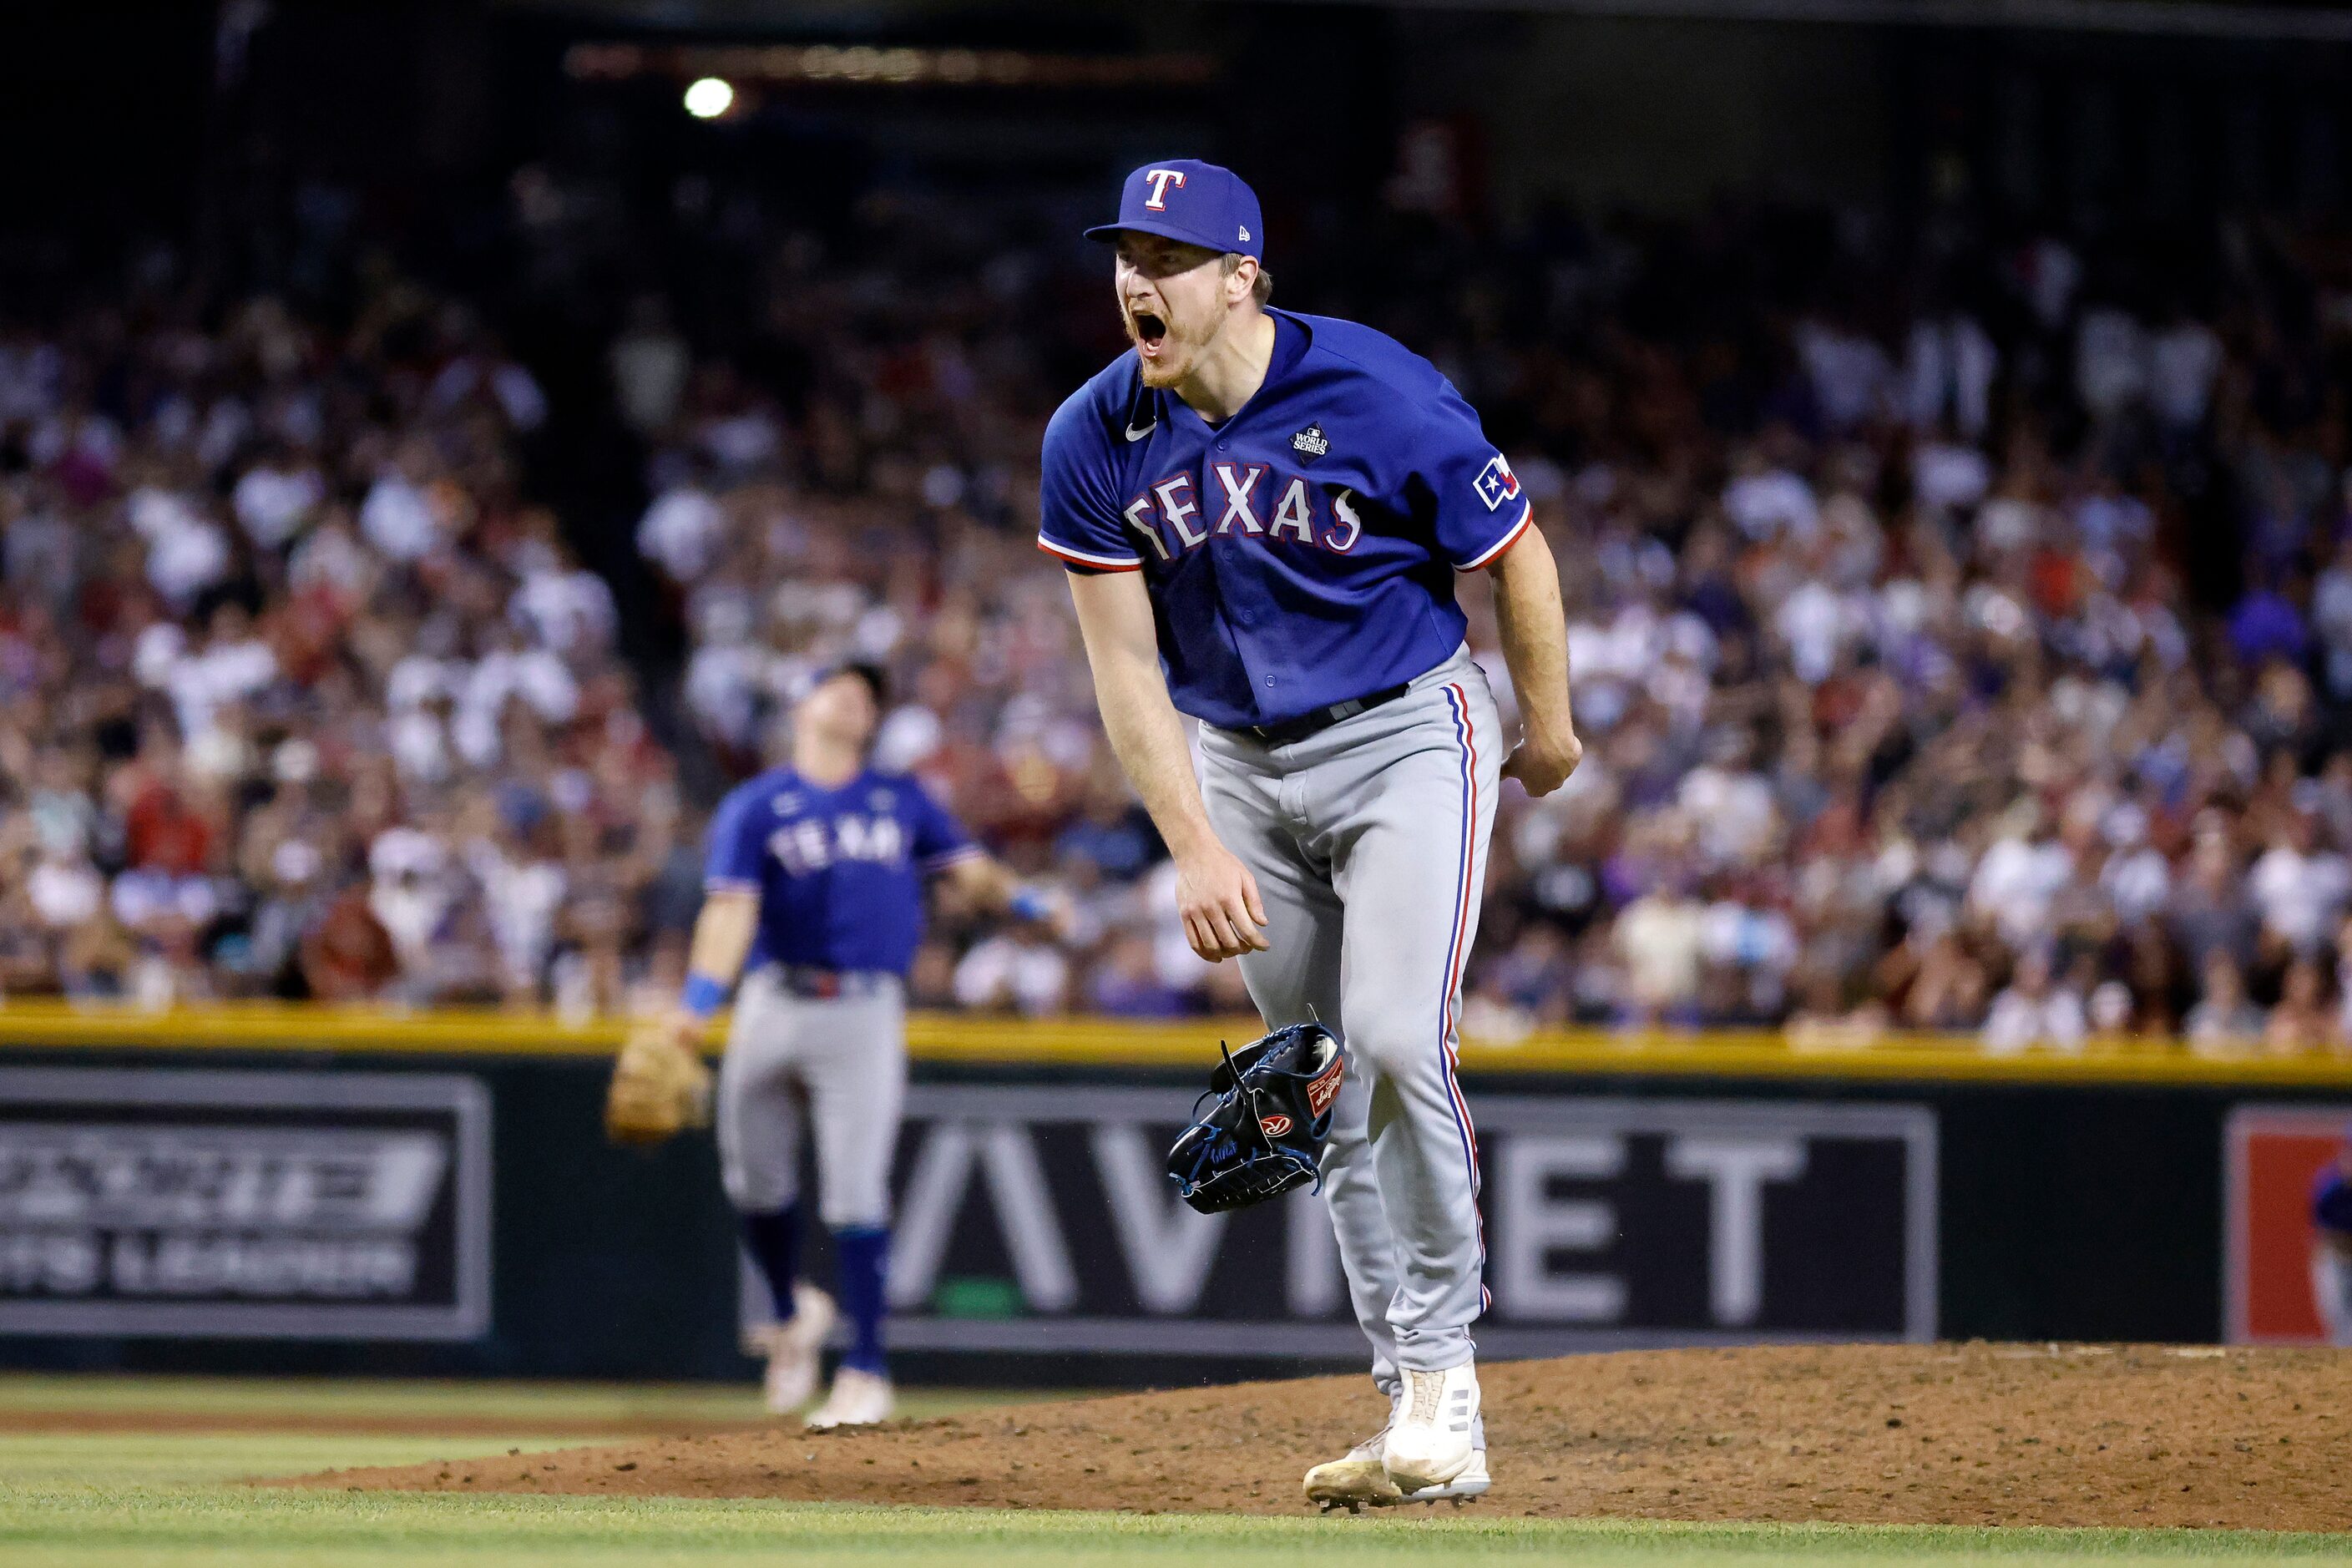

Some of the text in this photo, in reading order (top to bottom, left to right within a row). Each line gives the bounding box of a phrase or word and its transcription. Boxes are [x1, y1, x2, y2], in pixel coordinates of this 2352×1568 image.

[1146, 169, 1186, 211] T
[1293, 440, 1326, 455] SERIES
[1296, 432, 1328, 448] WORLD
[1124, 463, 1361, 561] TEXAS
